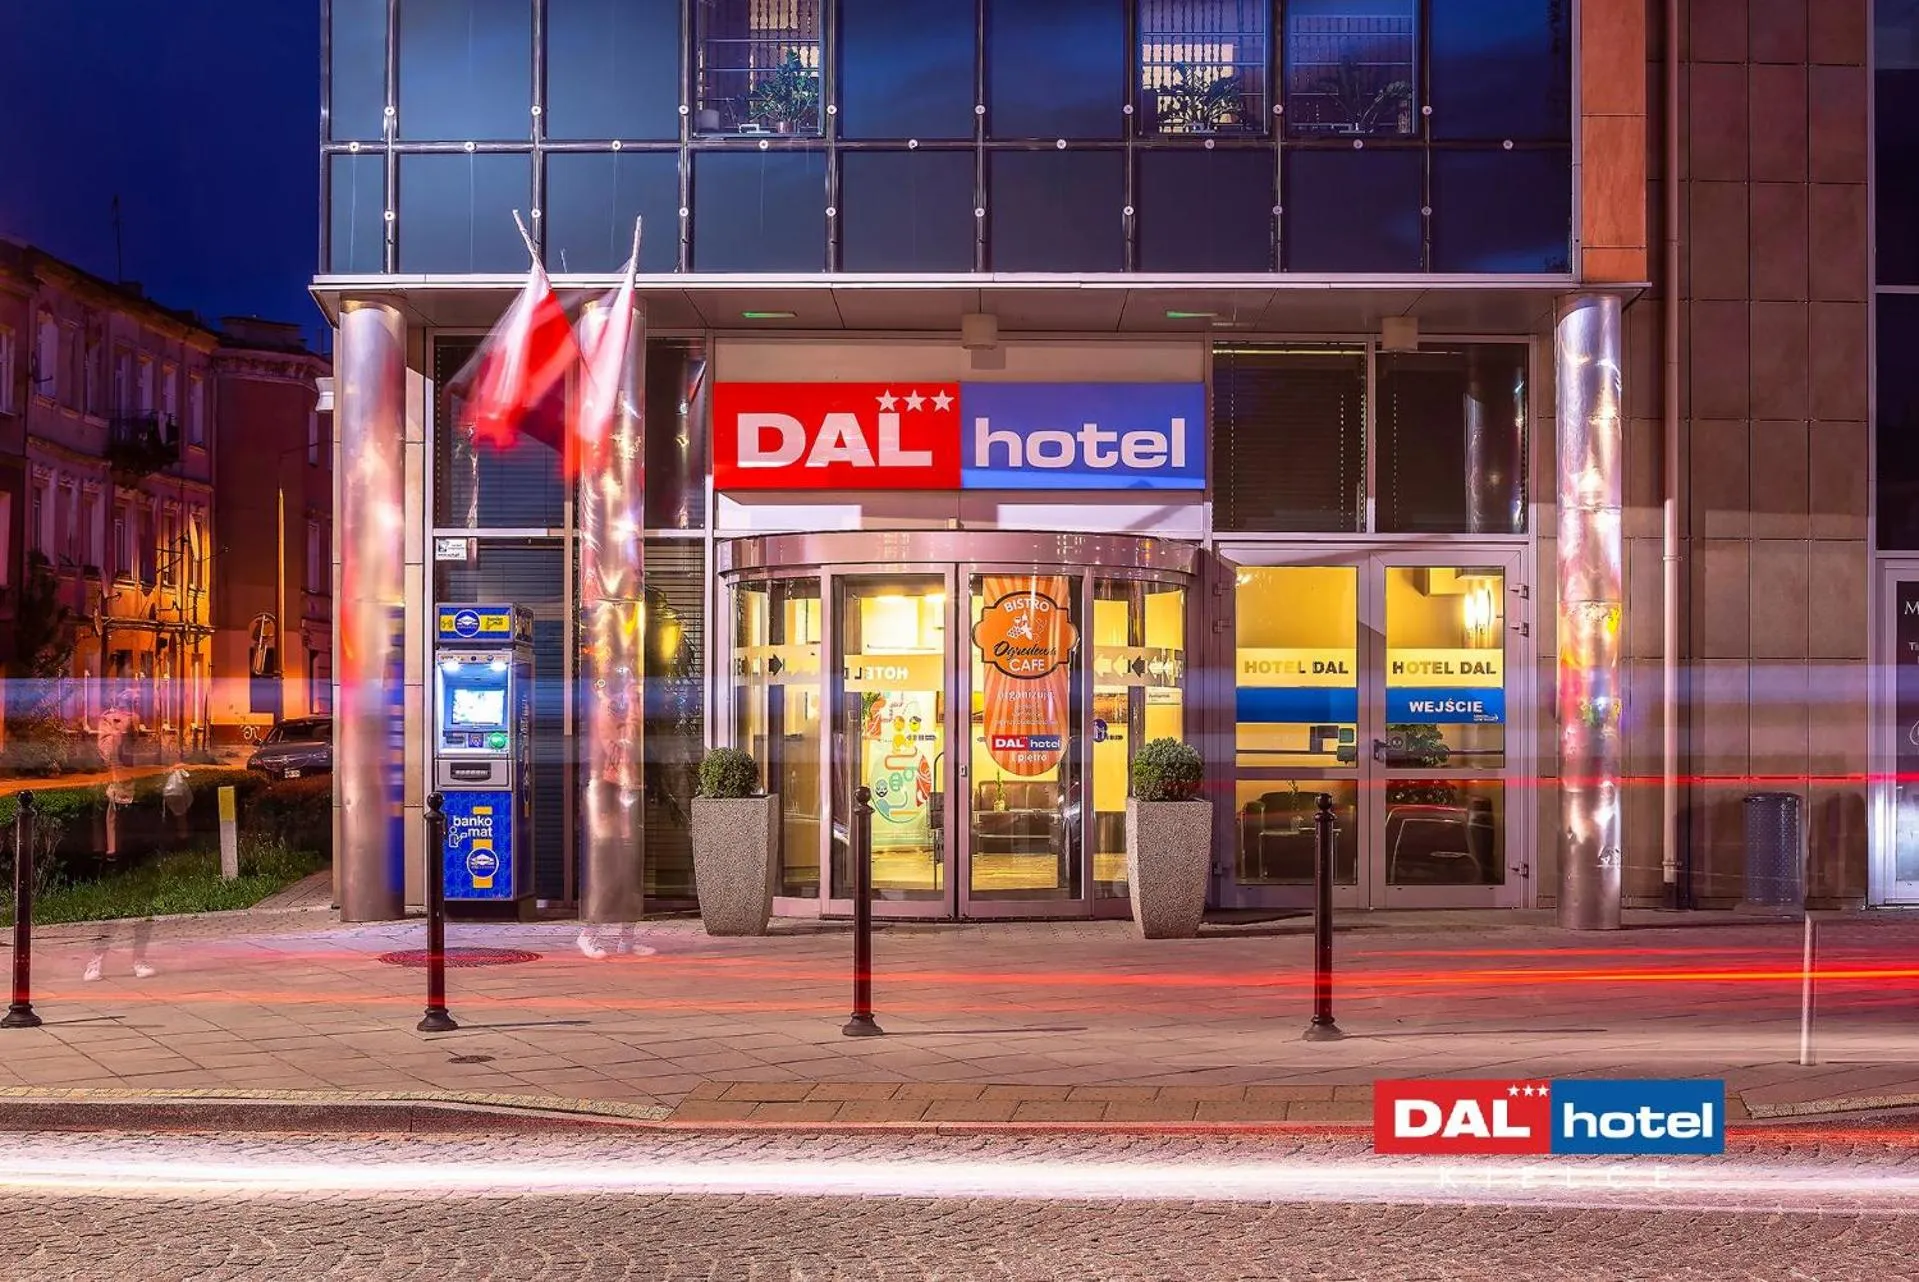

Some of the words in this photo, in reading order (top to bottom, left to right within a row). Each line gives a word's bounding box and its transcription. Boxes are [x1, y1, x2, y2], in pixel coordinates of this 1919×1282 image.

[737, 412, 933, 468] DAL
[975, 416, 1186, 469] hotel
[1003, 598, 1050, 613] BISTRO
[1009, 658, 1045, 672] CAFE
[1244, 660, 1306, 675] HOTEL
[1312, 660, 1349, 675] DAL
[1392, 660, 1454, 675] HOTEL
[1459, 660, 1497, 675] DAL
[1409, 697, 1483, 713] WEJŚCIE
[995, 739, 1025, 748] DAL
[1030, 739, 1061, 748] hotel
[453, 816, 493, 827] banko
[468, 827, 493, 838] mat
